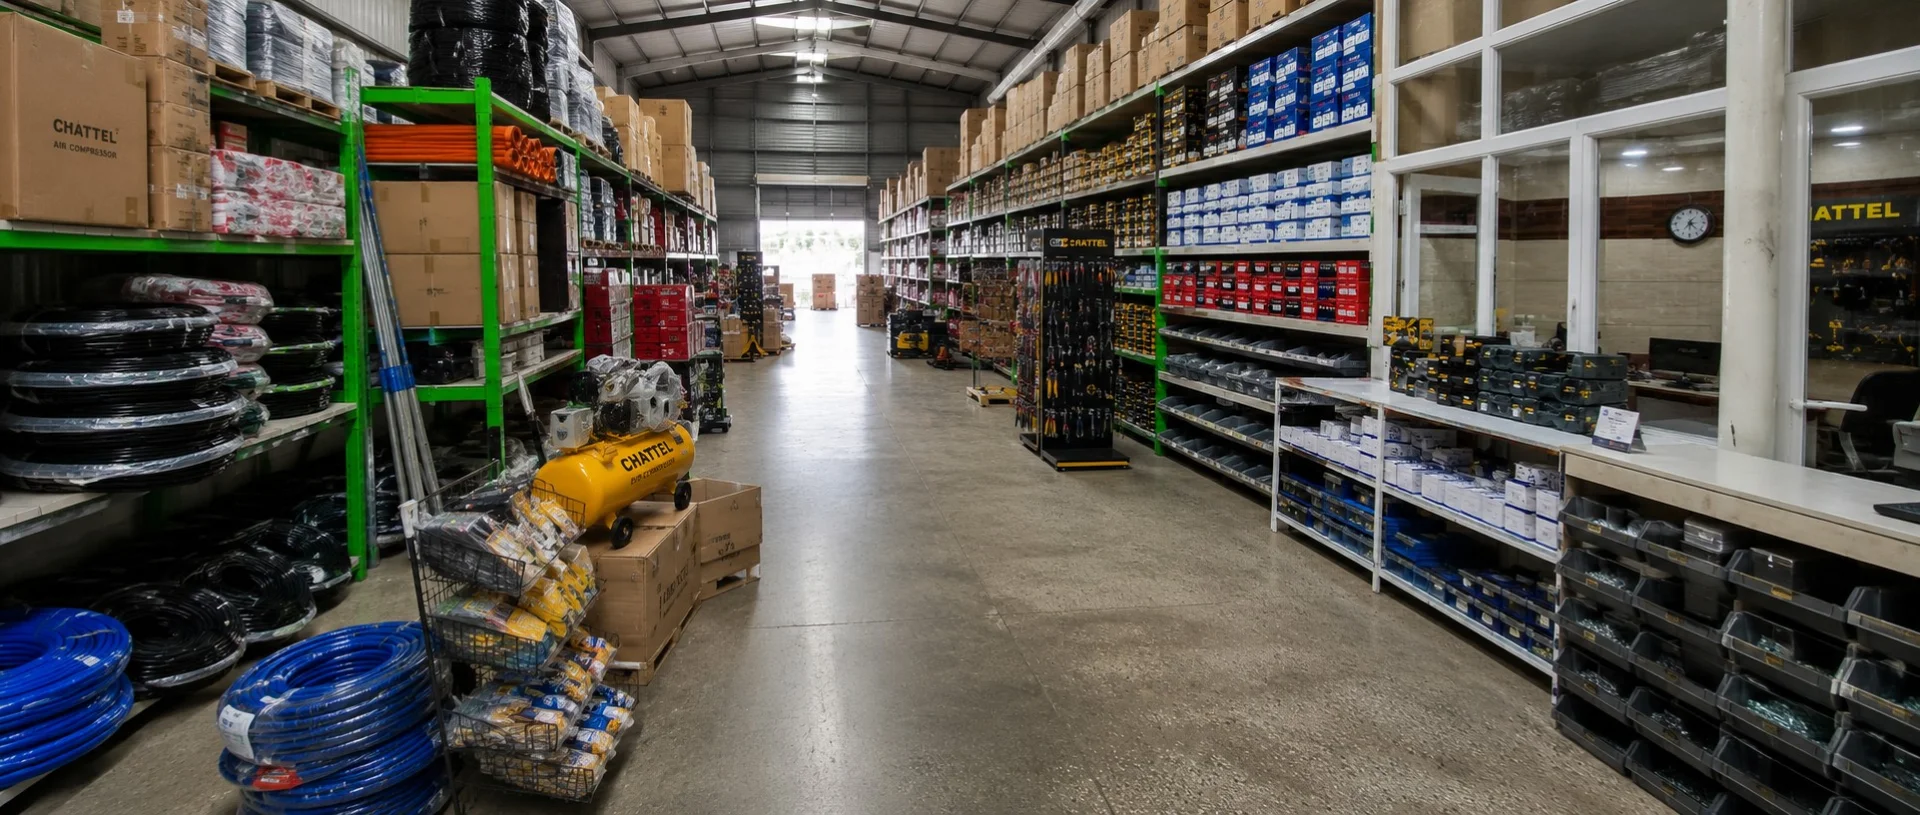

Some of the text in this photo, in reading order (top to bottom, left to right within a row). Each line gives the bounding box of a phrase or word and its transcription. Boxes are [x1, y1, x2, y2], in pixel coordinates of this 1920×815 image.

[53, 118, 117, 144] CHATTEL
[53, 141, 67, 150] AIR
[1810, 202, 1900, 221] ATTEL
[620, 441, 674, 472] CHATTEL
